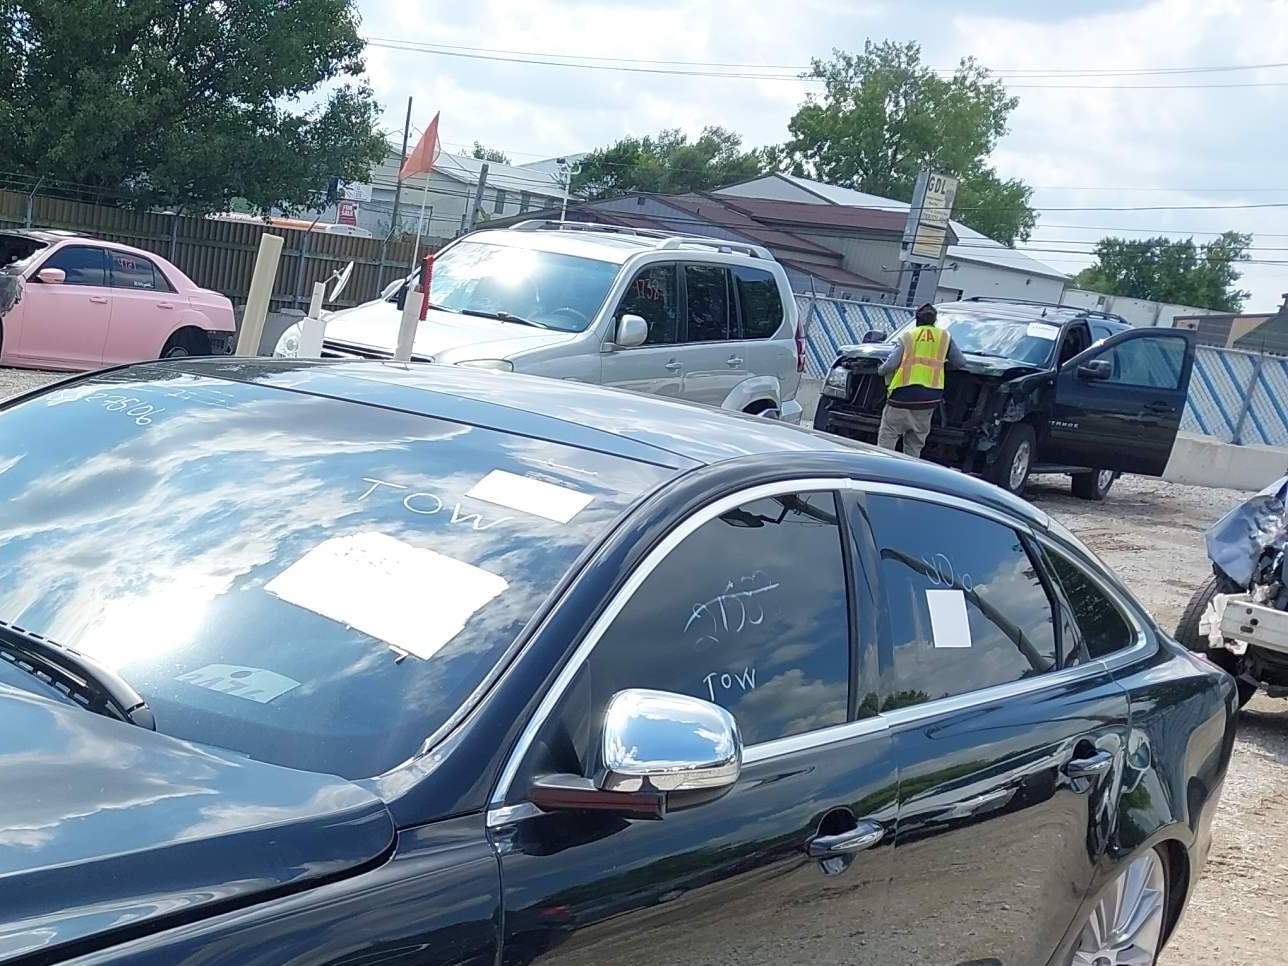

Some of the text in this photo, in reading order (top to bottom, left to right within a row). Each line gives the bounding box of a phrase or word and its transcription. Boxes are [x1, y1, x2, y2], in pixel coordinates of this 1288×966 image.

[928, 176, 946, 194] GDL
[358, 477, 514, 530] TOW
[703, 666, 756, 702] TOW
